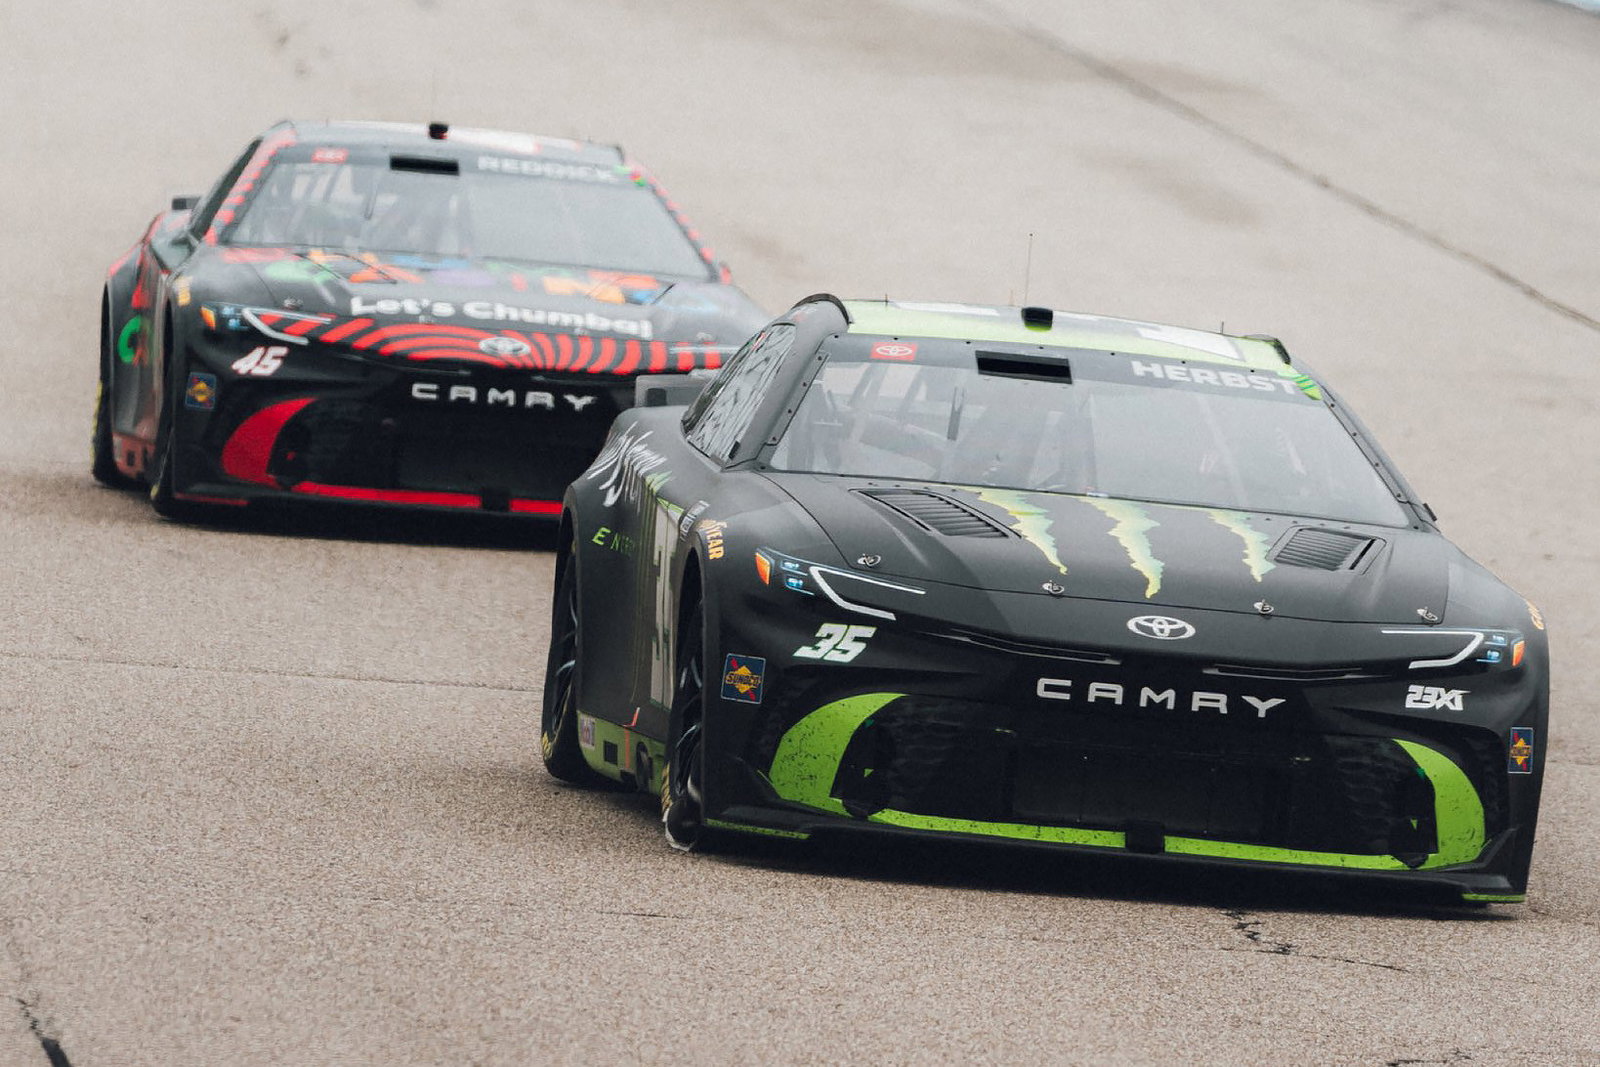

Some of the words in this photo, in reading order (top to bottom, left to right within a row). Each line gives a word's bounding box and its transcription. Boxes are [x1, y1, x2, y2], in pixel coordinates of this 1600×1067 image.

[351, 296, 455, 317] Let's
[231, 346, 289, 376] 45
[1131, 361, 1297, 395] HERBST
[411, 382, 597, 412] CAMRY
[792, 623, 877, 663] 35
[1036, 677, 1286, 718] CAMRY
